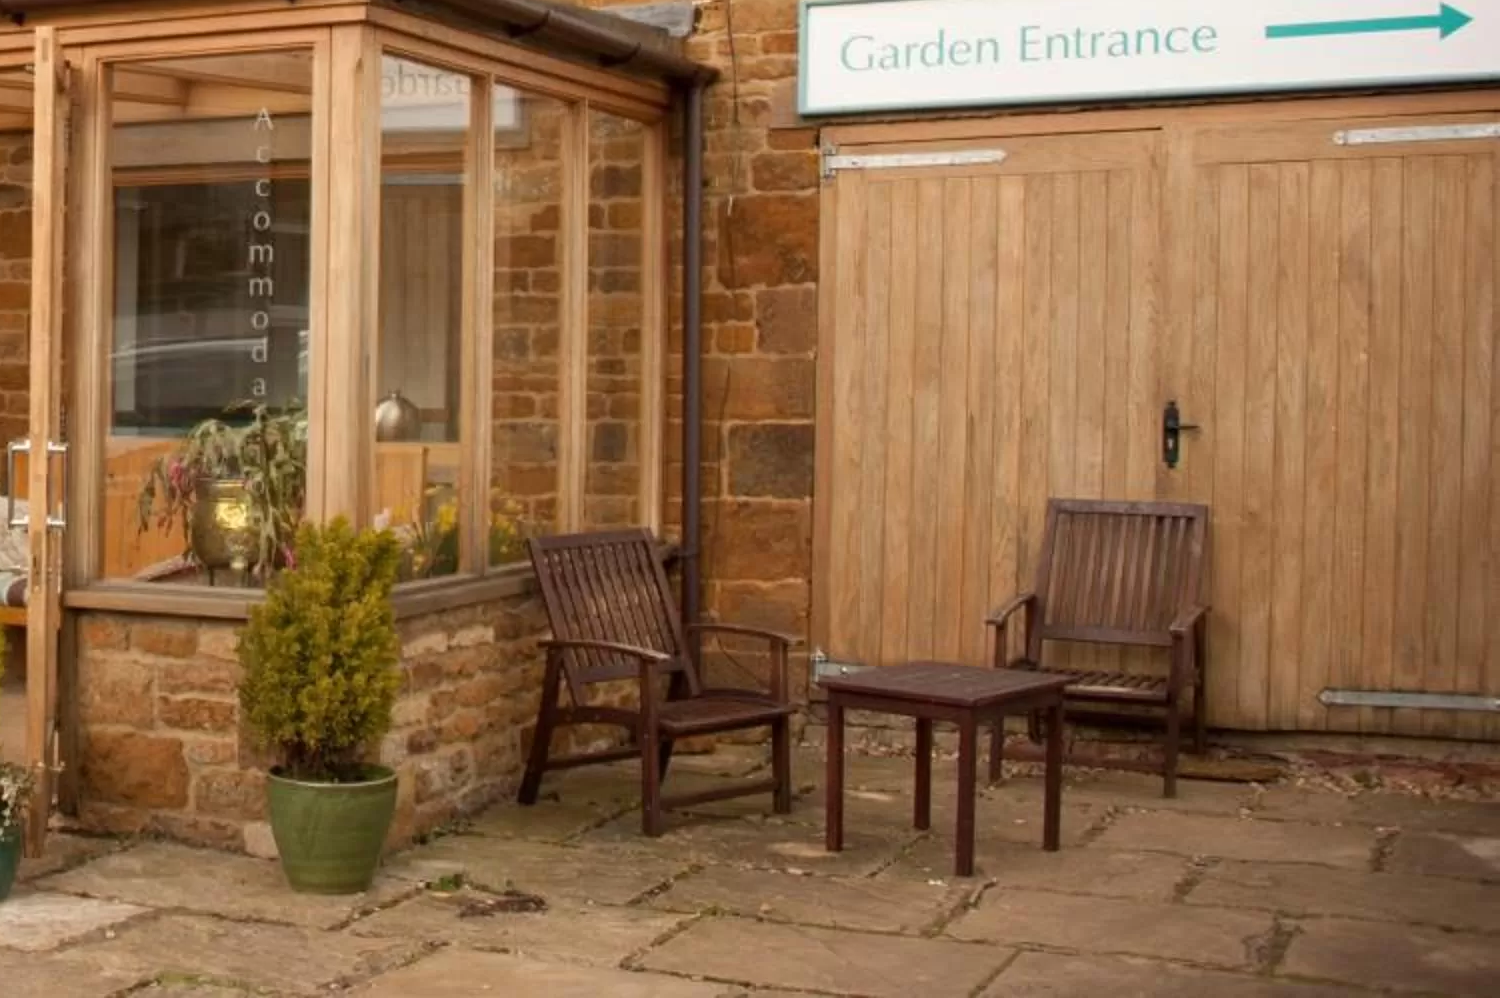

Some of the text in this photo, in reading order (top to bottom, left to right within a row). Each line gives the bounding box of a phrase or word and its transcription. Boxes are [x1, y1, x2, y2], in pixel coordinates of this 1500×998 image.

[840, 25, 1218, 72] Garden Entrance
[248, 106, 275, 498] Accommoda
